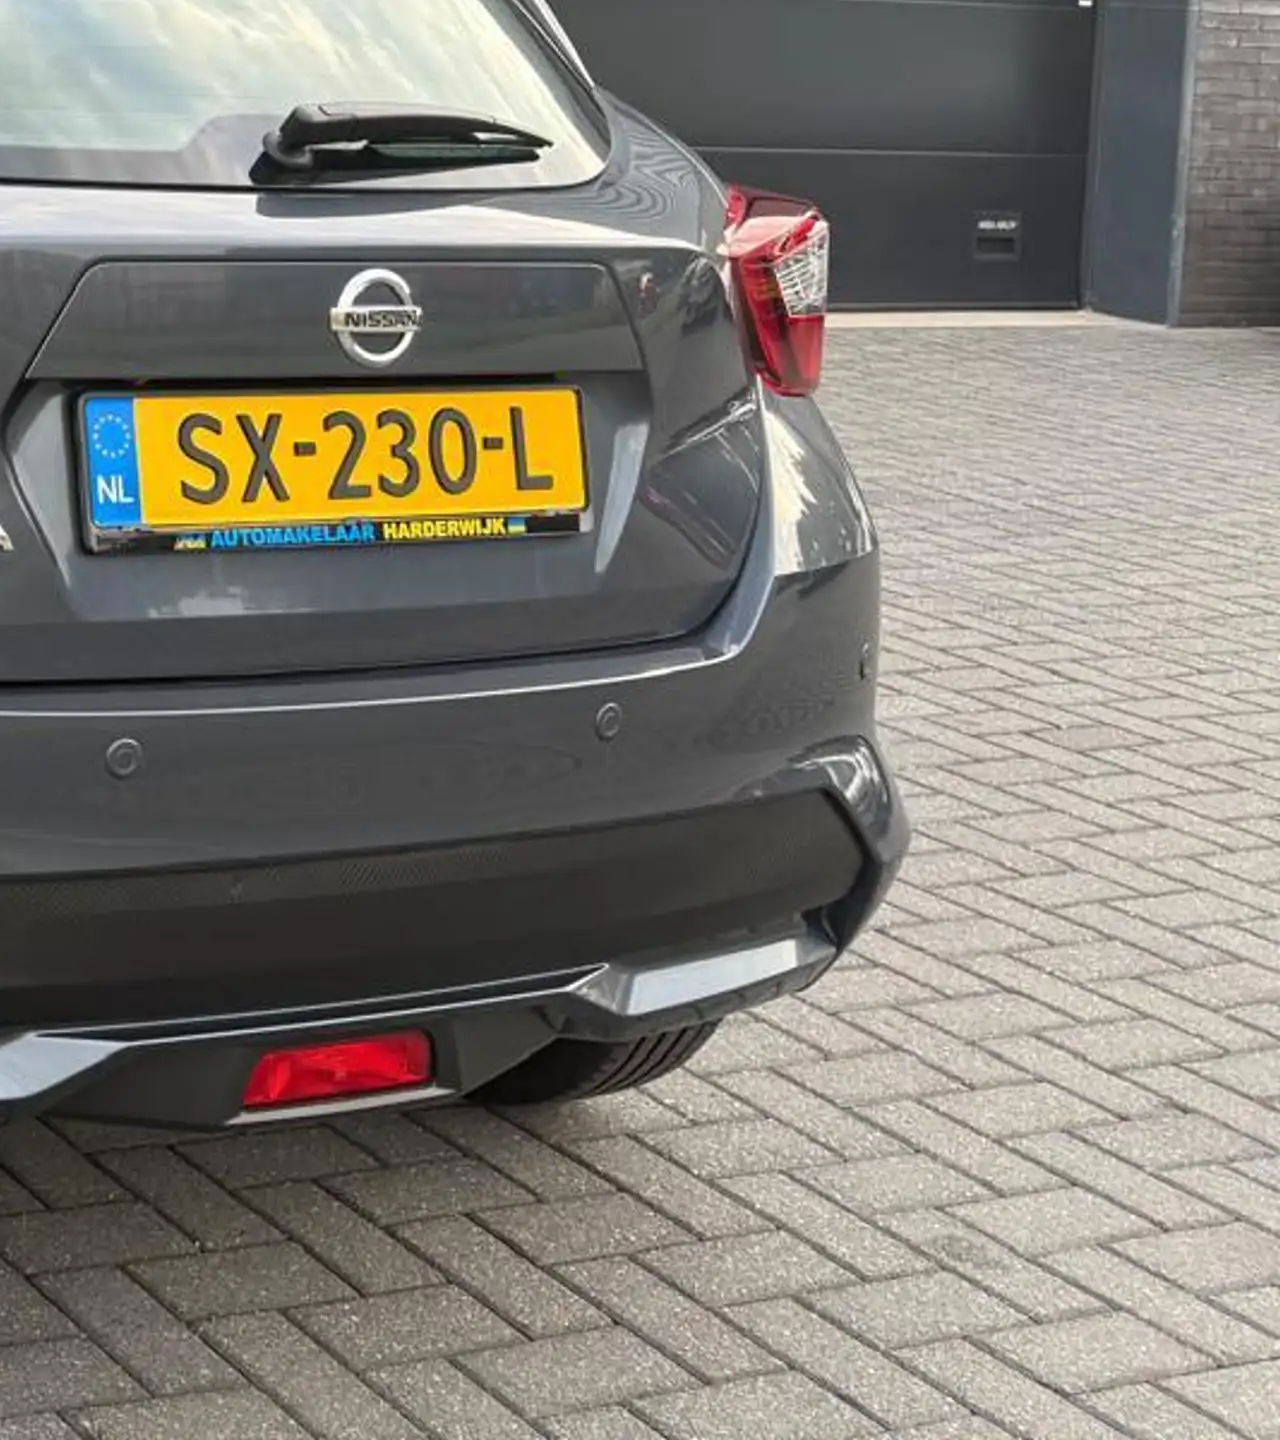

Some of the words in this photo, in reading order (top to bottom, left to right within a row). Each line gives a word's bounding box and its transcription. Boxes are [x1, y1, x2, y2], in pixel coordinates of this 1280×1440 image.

[344, 309, 419, 328] NISSAN
[176, 406, 554, 505] SX-230-L
[97, 474, 134, 504] NL
[210, 523, 375, 548] AUTOMAKELAAR
[382, 517, 507, 540] HARDERWIJK
